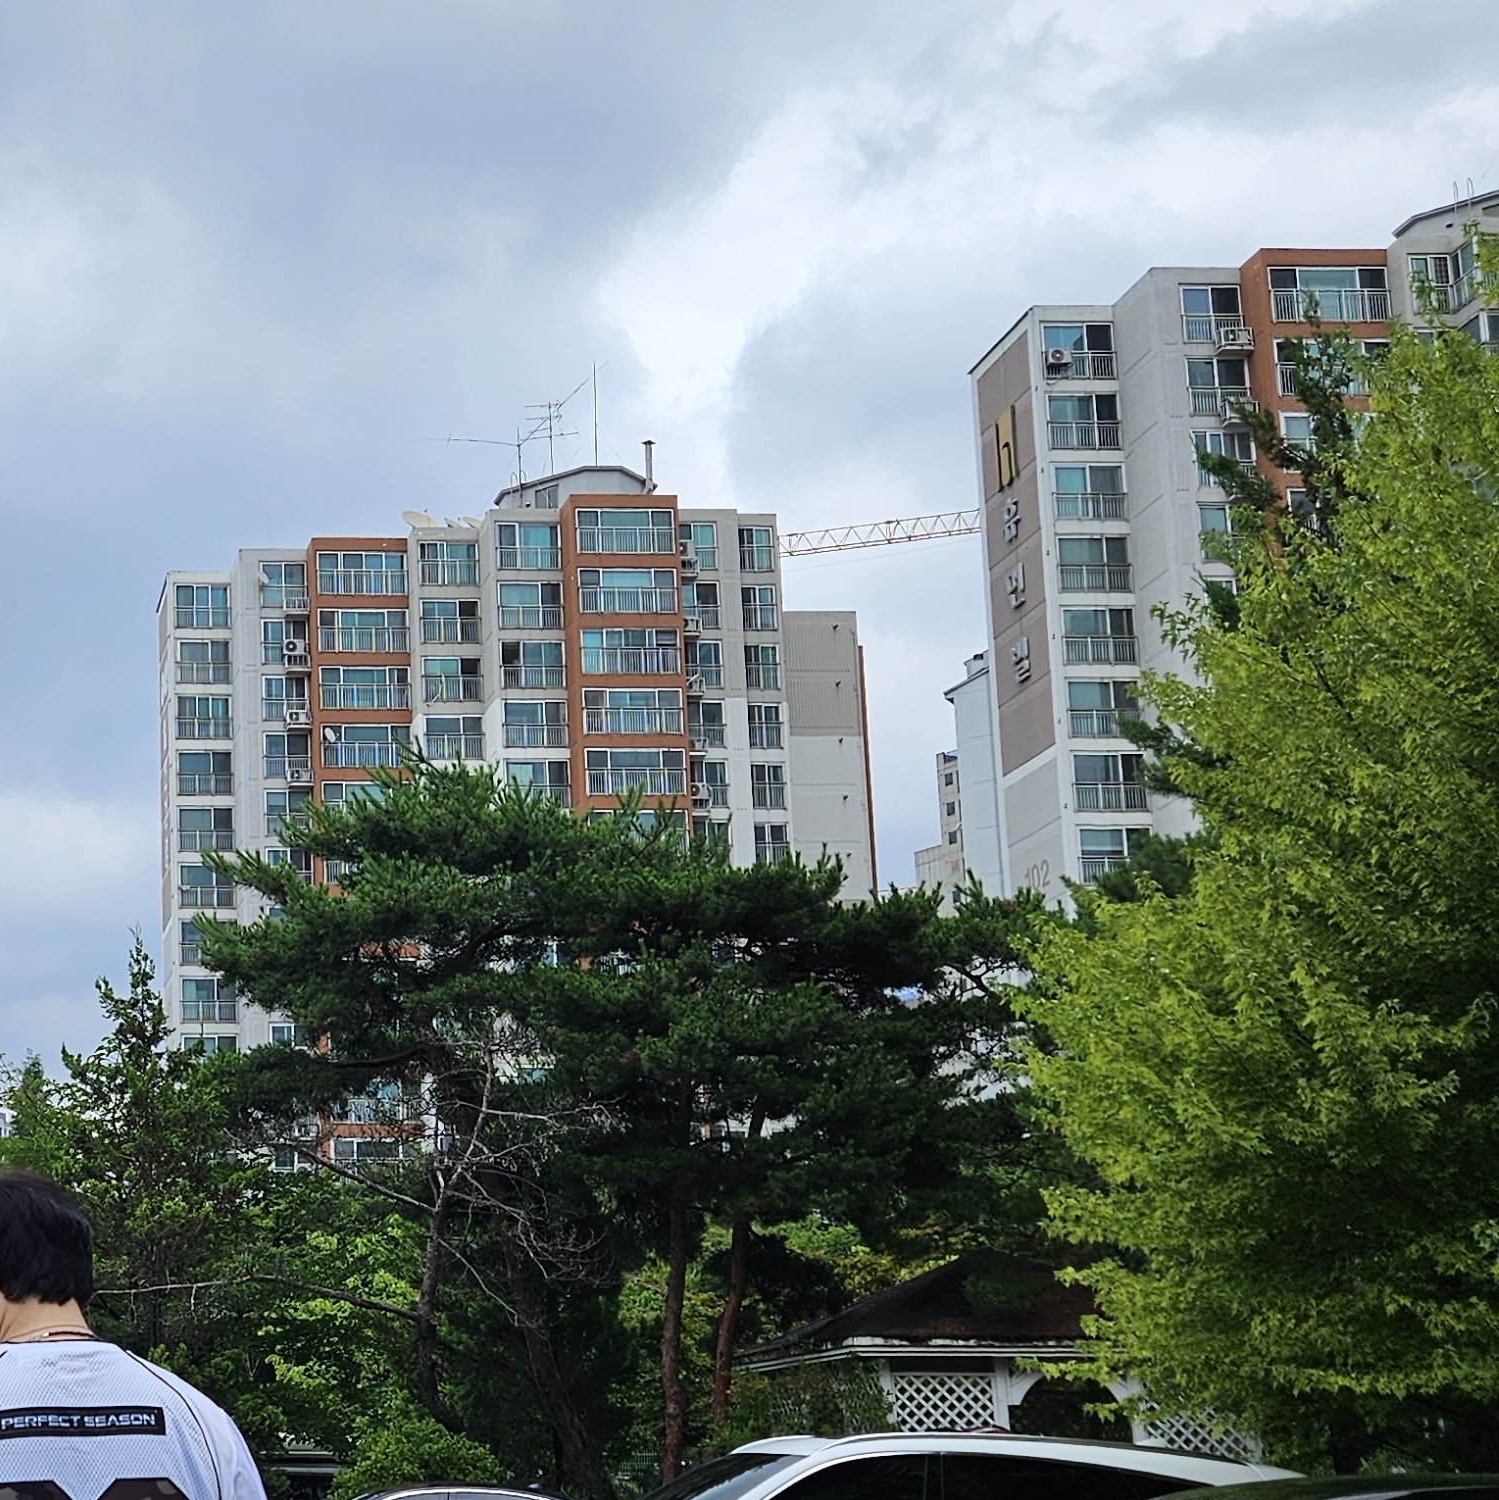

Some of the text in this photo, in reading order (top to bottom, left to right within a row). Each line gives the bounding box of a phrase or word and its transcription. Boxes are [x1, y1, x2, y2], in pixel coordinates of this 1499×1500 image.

[1002, 497, 1031, 684] 휴먼빌
[1024, 859, 1050, 891] 102
[1, 1413, 156, 1430] PERFECT SEASON
